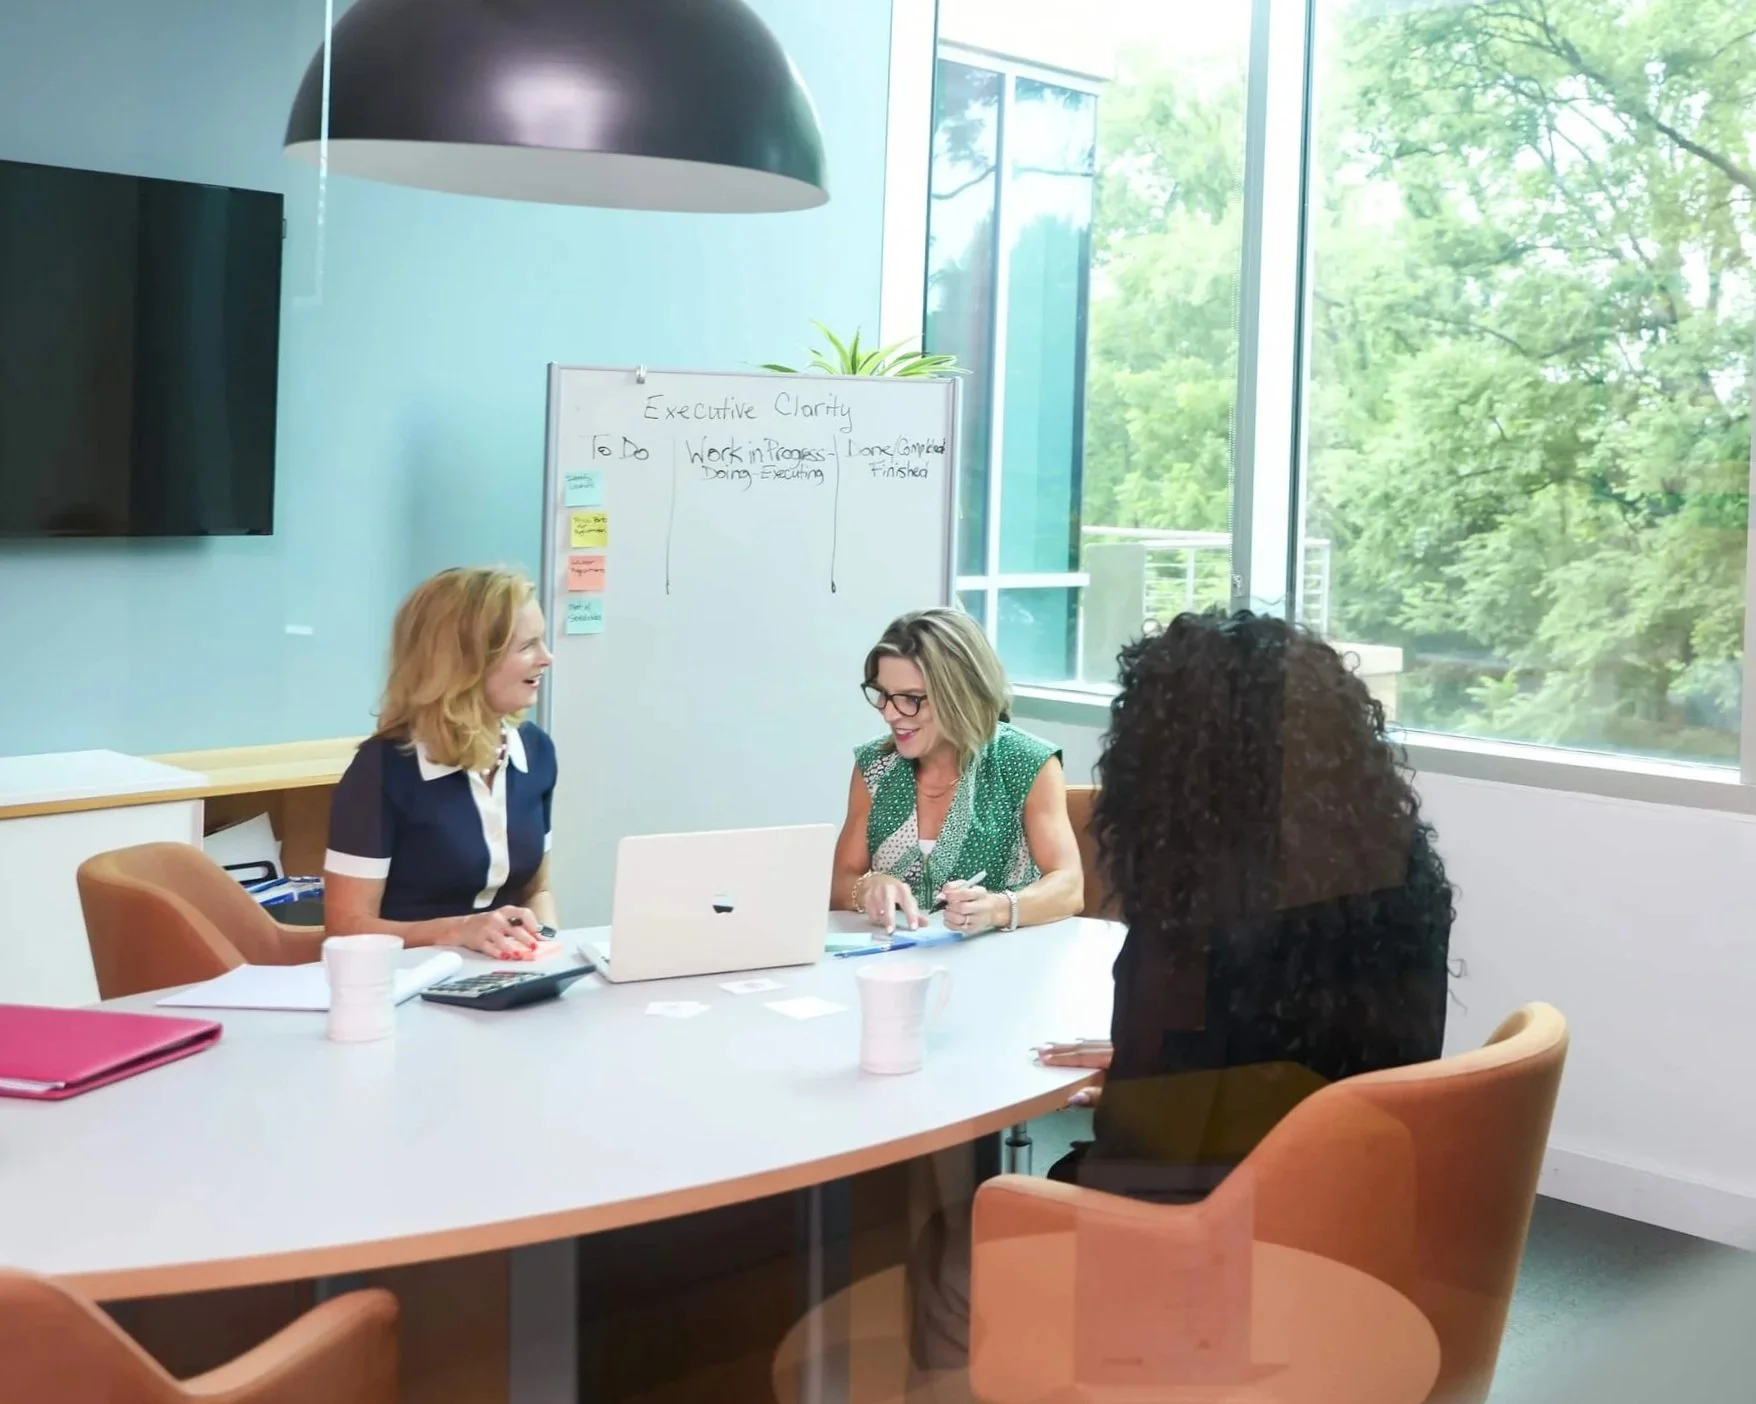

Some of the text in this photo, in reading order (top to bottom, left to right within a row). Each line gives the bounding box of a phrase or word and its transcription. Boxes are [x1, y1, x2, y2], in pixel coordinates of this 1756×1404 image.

[644, 391, 853, 433] Executive Clarity
[586, 434, 649, 461] To Do
[685, 436, 743, 464] Work
[749, 440, 763, 465] in
[869, 460, 929, 479] Finished
